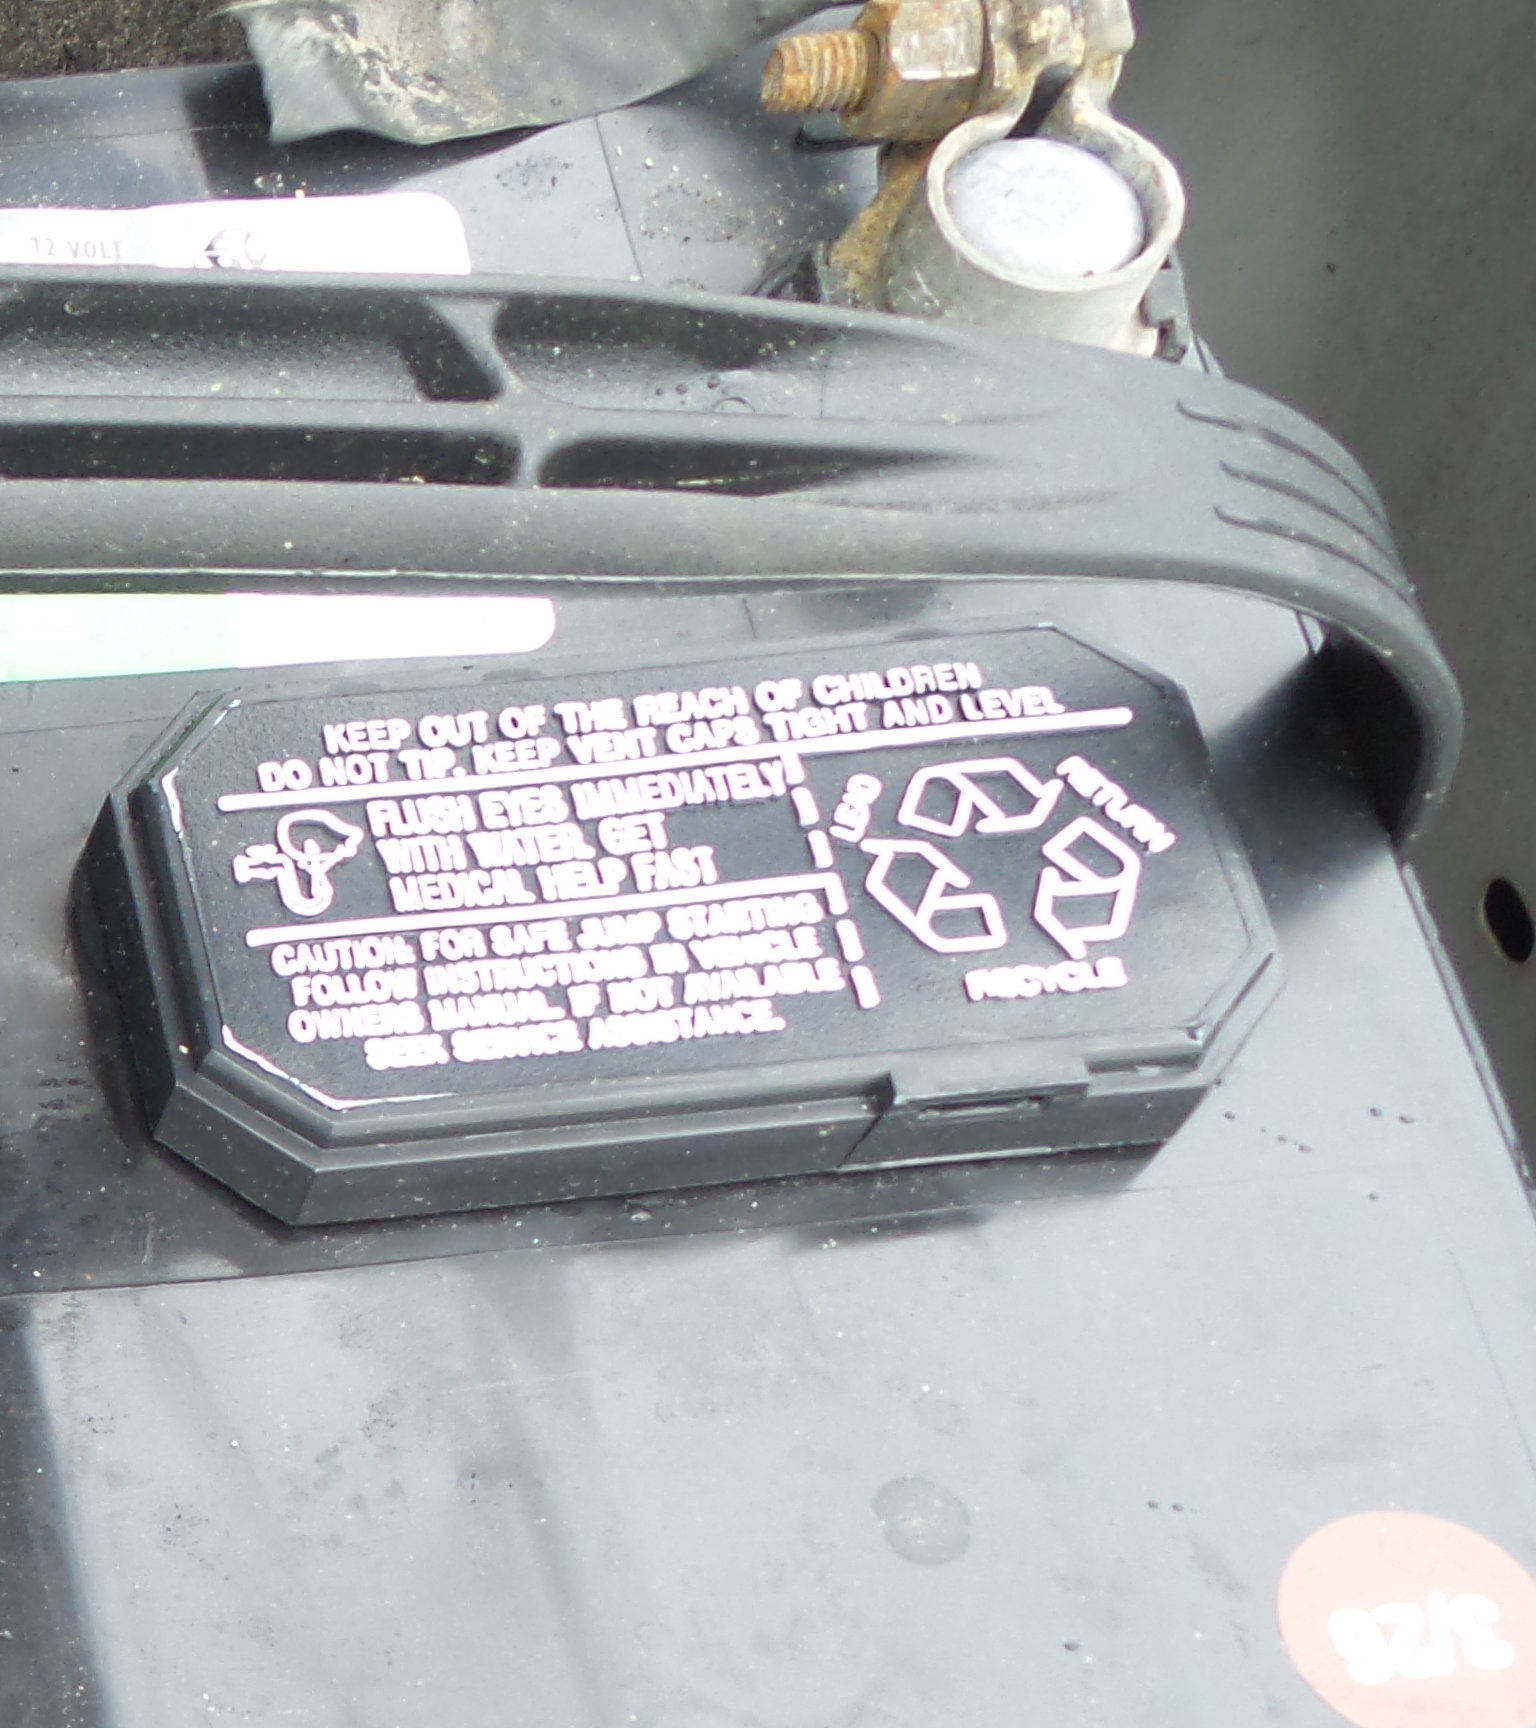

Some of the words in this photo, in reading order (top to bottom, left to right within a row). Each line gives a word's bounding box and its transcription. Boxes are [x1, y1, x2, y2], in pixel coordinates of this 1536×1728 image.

[67, 239, 122, 261] VOLT
[257, 759, 313, 793] DO
[318, 752, 391, 786] NOT
[471, 737, 561, 776] KEEP
[565, 727, 658, 764] VENT
[665, 717, 761, 754] CAPS
[763, 701, 868, 742] TIGHT
[881, 694, 953, 730] AND
[960, 686, 1066, 721] LEVEL
[322, 718, 412, 754] KEEP
[418, 710, 490, 748] OUT
[497, 704, 547, 739] OF
[553, 698, 628, 735] THE
[633, 686, 750, 727] REACH
[754, 677, 804, 712] OF
[812, 662, 983, 704] CHILDREN
[366, 794, 478, 838] FLUSH
[478, 785, 569, 830] EYES
[570, 760, 787, 821] IMMEDIATELY
[375, 834, 468, 874] WITH
[598, 812, 668, 855] GET
[388, 868, 536, 913] MEDICAL
[536, 857, 627, 901] HELP
[630, 845, 719, 892] FAST
[419, 927, 487, 961] FOR
[489, 919, 573, 957] SAFE
[666, 892, 824, 941] STARTING
[291, 967, 418, 1007] FOLLOW
[606, 975, 675, 1014] NOT
[683, 957, 846, 1005] AVAILABLE
